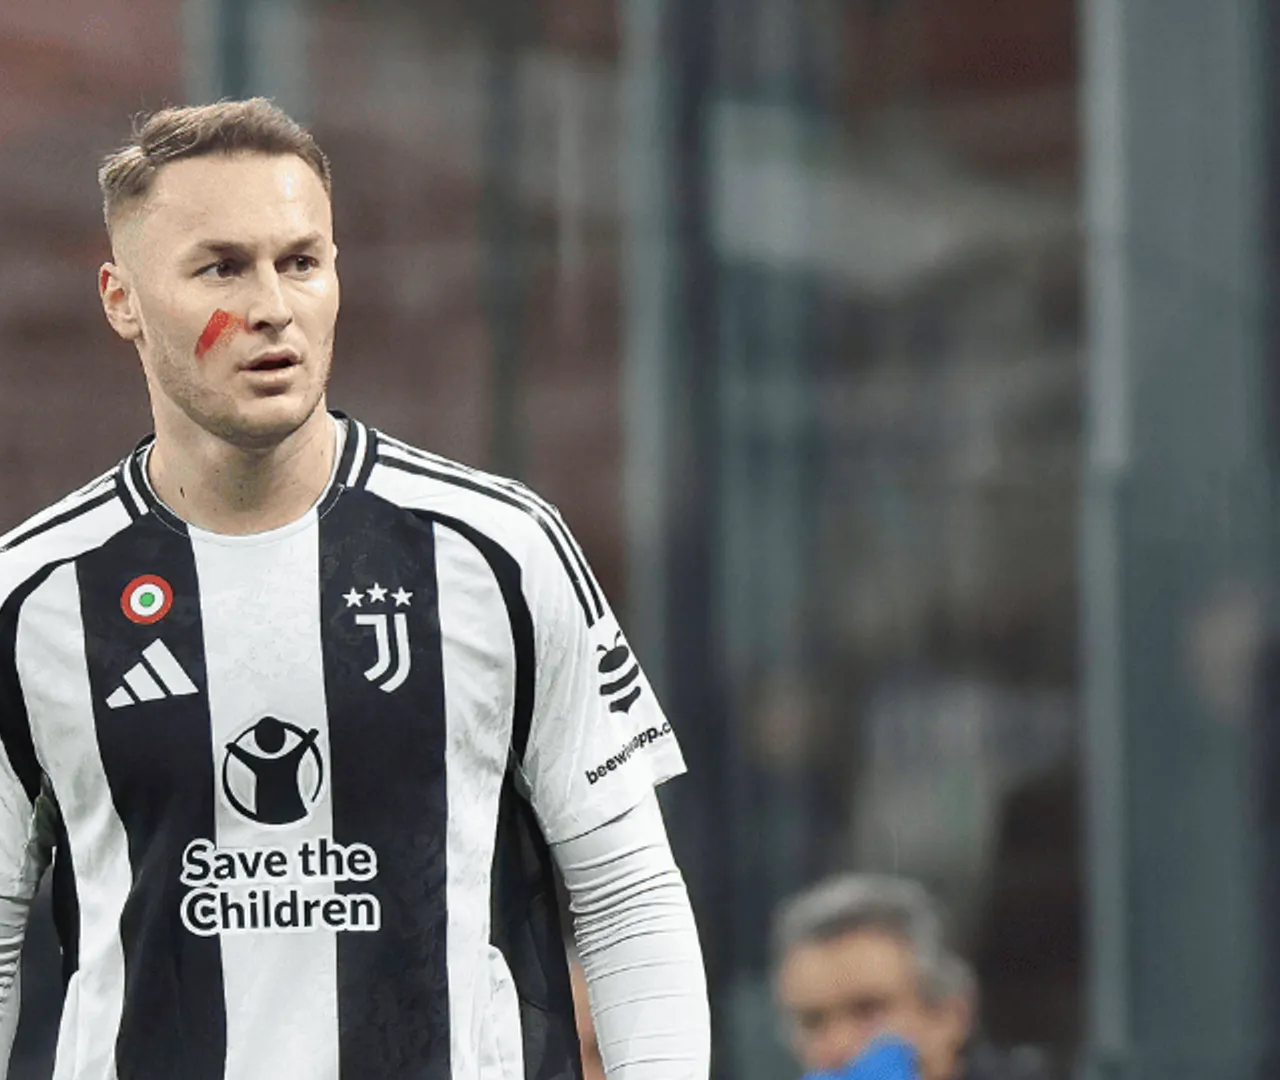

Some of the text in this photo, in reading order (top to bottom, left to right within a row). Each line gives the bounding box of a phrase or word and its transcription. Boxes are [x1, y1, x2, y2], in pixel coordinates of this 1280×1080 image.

[185, 838, 372, 881] Save the
[186, 890, 375, 931] Children
